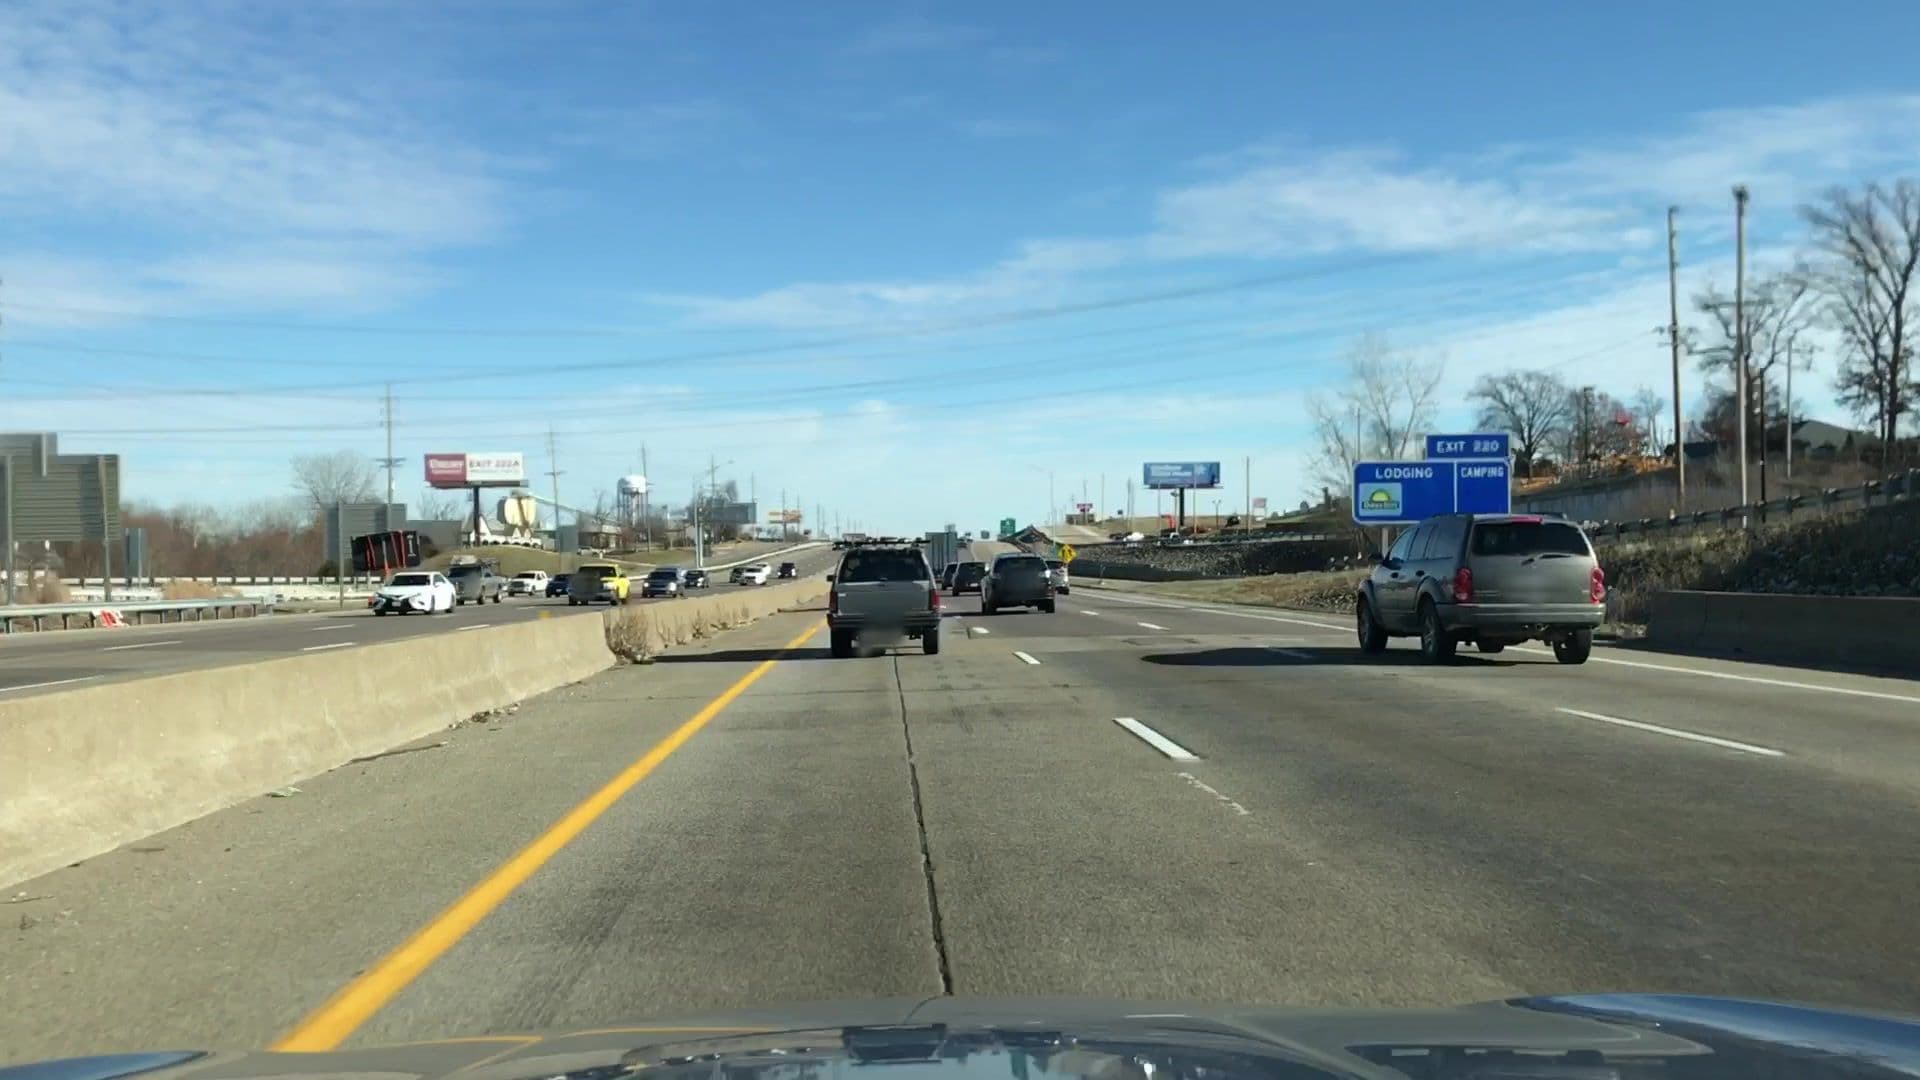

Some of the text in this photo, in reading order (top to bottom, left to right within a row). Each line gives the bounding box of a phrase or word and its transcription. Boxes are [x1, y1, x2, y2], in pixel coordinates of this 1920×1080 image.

[1436, 441, 1466, 453] EXIT
[469, 459, 491, 468] EXIT
[1375, 467, 1433, 479] LODGING
[1460, 466, 1504, 478] CAMPING
